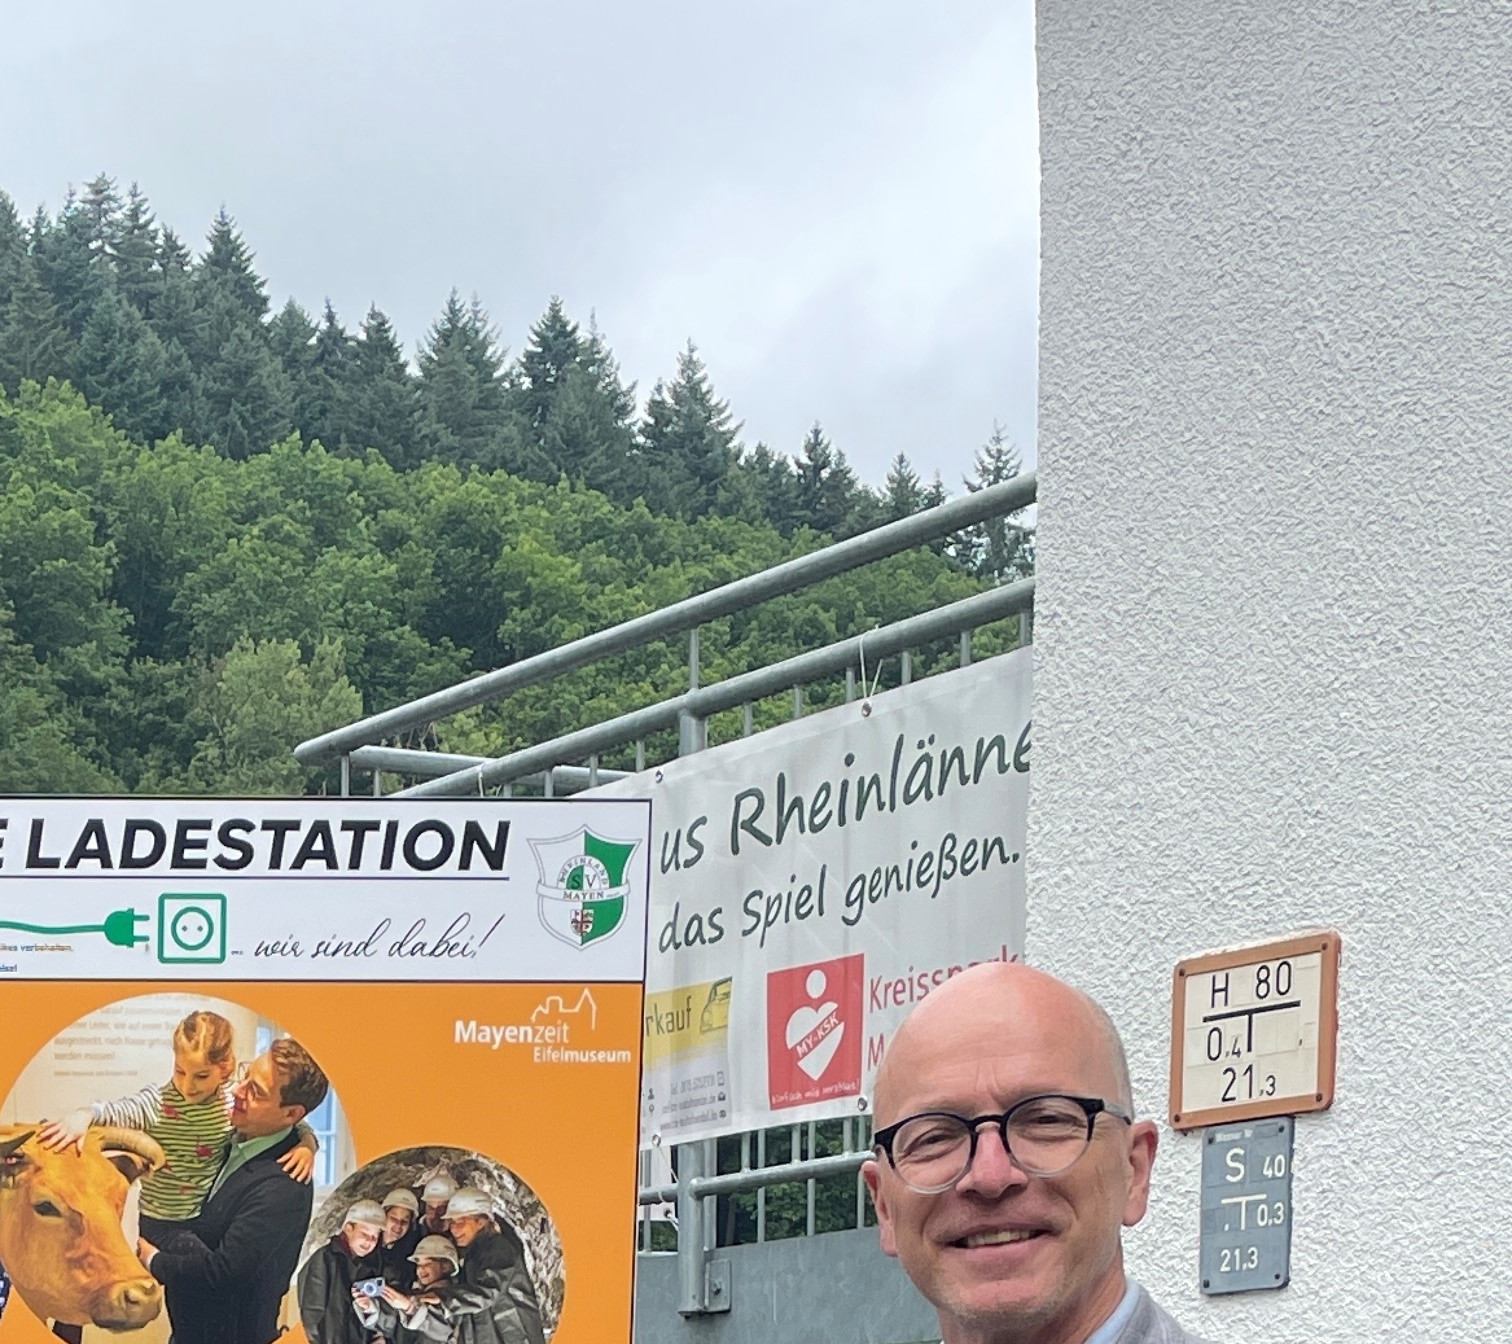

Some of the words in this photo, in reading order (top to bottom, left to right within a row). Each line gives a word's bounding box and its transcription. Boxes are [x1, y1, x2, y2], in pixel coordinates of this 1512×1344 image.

[25, 818, 511, 872] LADESTATION
[563, 891, 605, 900] MAYEN
[659, 901, 724, 953] das
[741, 864, 827, 948] Spiel
[841, 833, 1020, 926] genießen.
[254, 934, 305, 958] wir
[311, 917, 392, 958] sind
[387, 912, 506, 959] dabei!
[1210, 972, 1230, 1009] H
[1255, 960, 1292, 999] 80
[454, 1019, 570, 1050] Mayenzeit
[533, 1046, 632, 1064] Eifelmuseum
[1224, 1147, 1246, 1183] S
[1262, 1154, 1286, 1179] 40
[1219, 1246, 1259, 1272] 21,3
